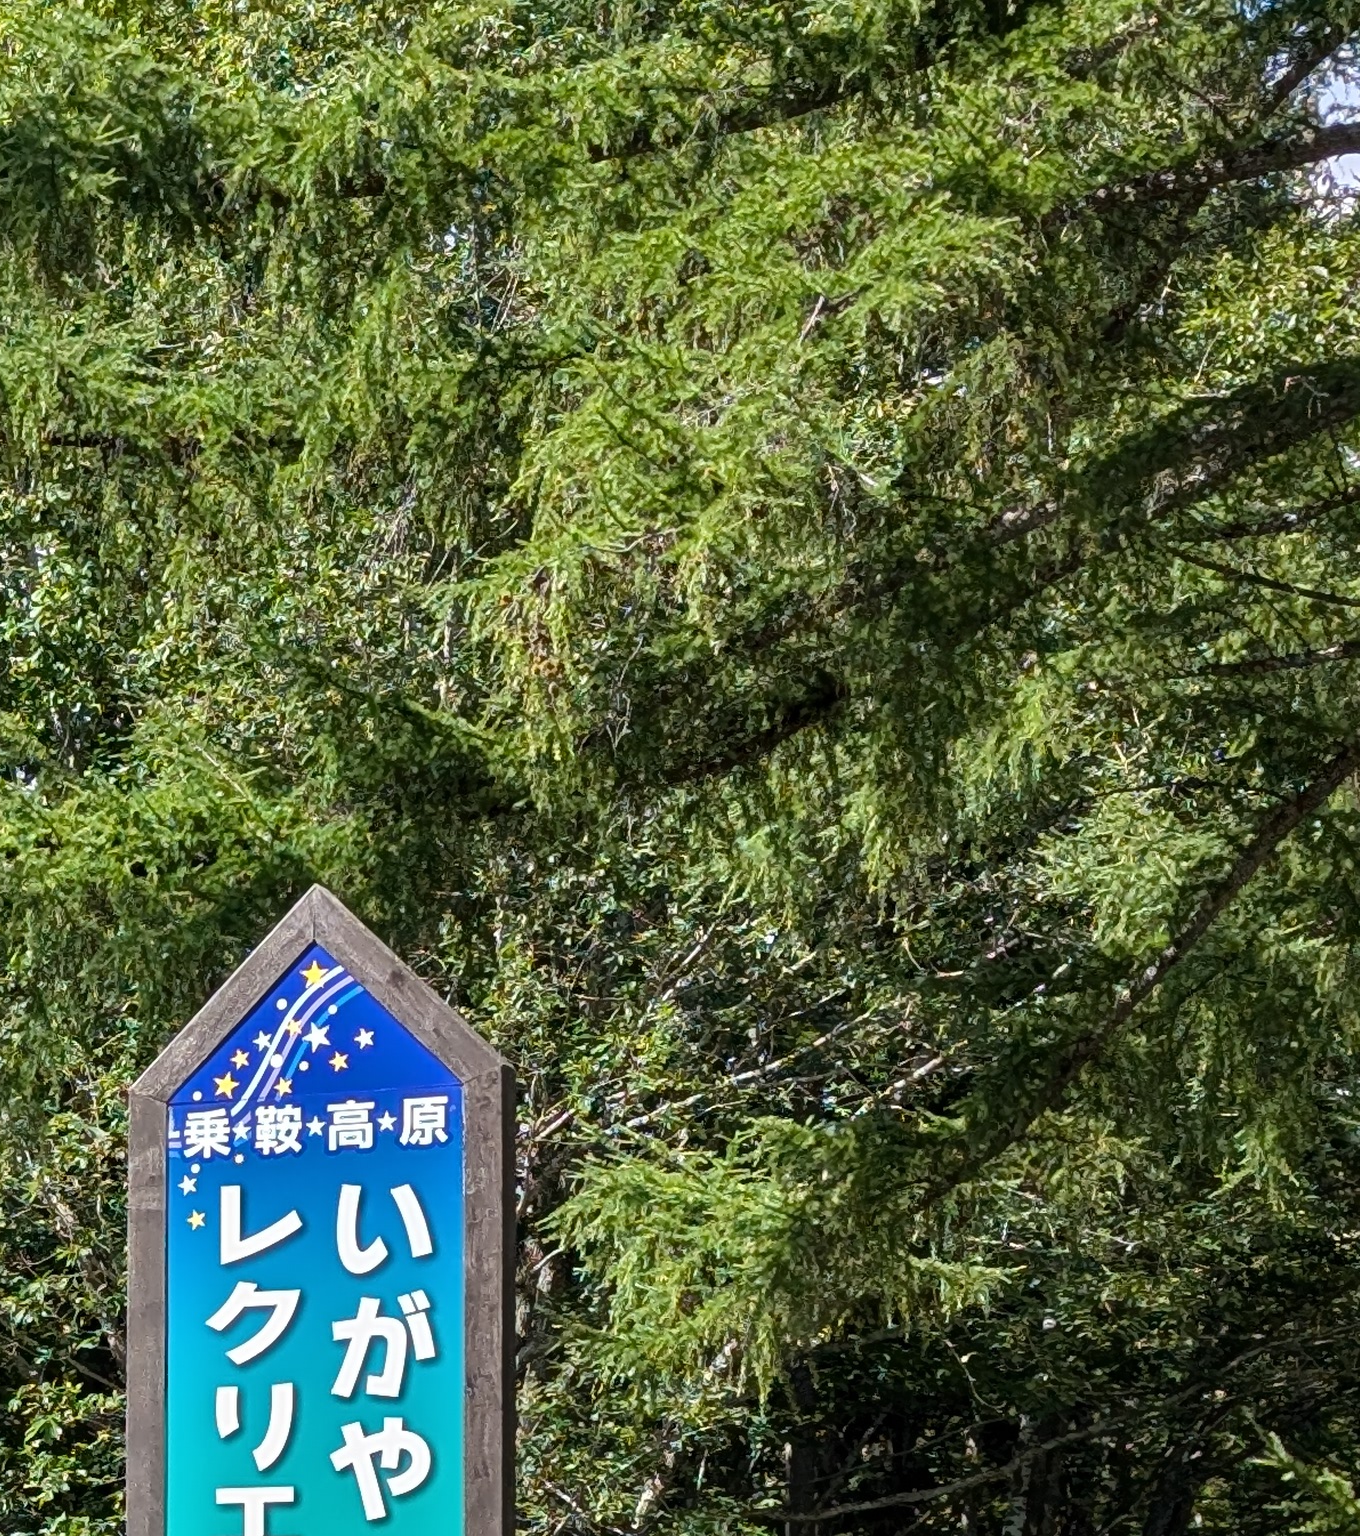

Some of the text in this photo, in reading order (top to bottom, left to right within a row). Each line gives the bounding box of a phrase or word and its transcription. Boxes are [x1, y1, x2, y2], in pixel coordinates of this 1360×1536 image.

[183, 1096, 448, 1158] 乗鞍高原
[330, 1184, 436, 1521] いがや
